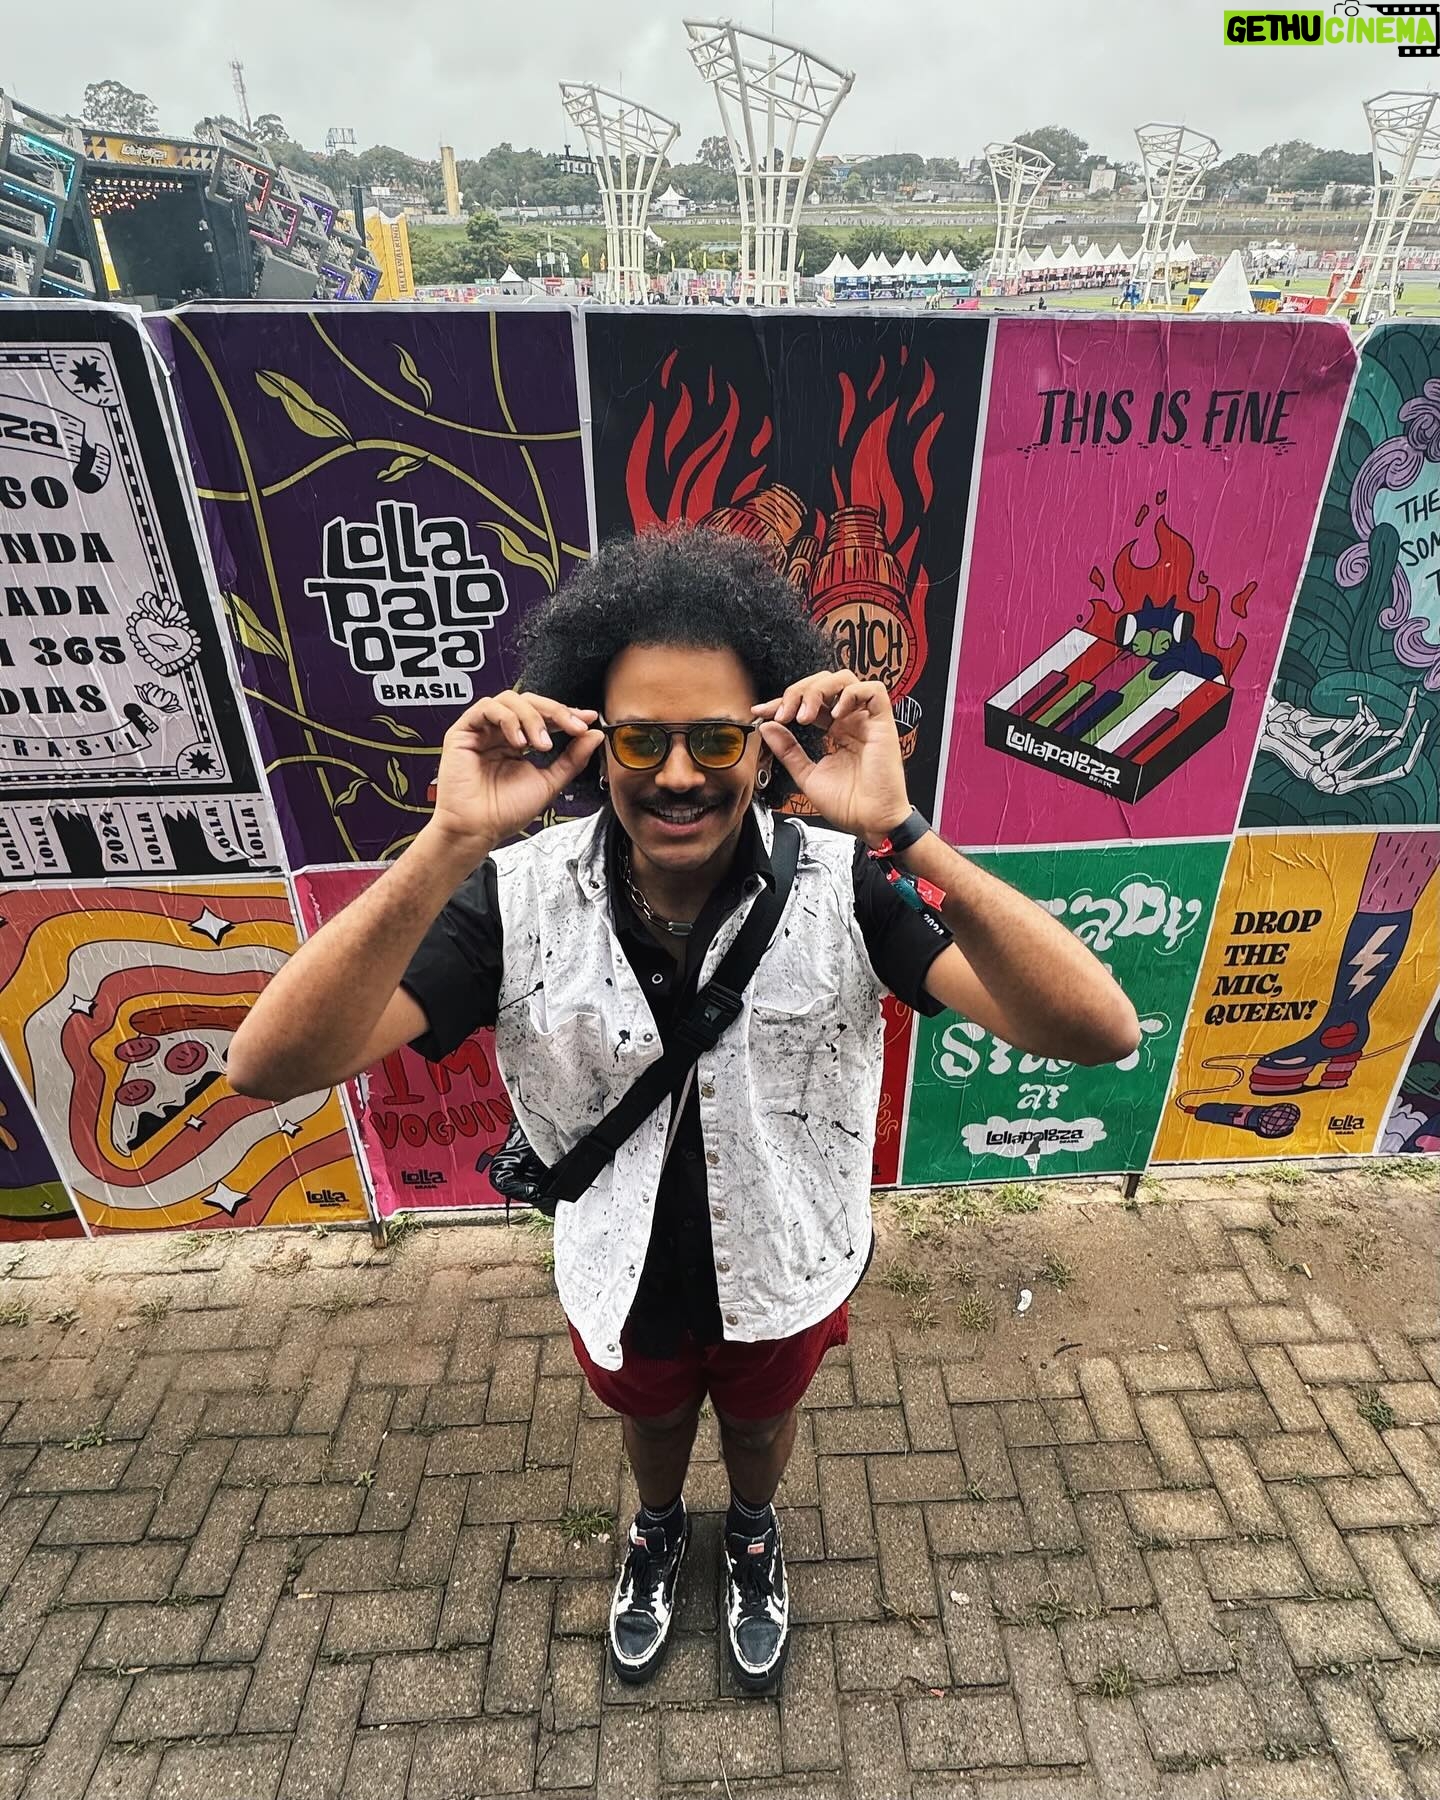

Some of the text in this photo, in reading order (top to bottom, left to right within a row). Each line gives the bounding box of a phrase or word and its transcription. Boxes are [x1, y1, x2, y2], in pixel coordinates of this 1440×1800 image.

[1038, 389, 1300, 445] THIS IS FINE
[0, 532, 115, 564] NDA
[0, 586, 110, 617] ADA
[29, 636, 126, 666] 365
[381, 683, 467, 699] BRASIL
[29, 816, 58, 868] LOLLA
[100, 812, 129, 864] 2024
[137, 812, 165, 864] LOLLA
[241, 807, 267, 860] LOLLA
[1231, 910, 1322, 936] DROP
[1224, 943, 1290, 967] THE
[1212, 973, 1283, 997] MIC,
[1204, 999, 1319, 1025] QUEEN!
[369, 1092, 513, 1149] VOGUIN
